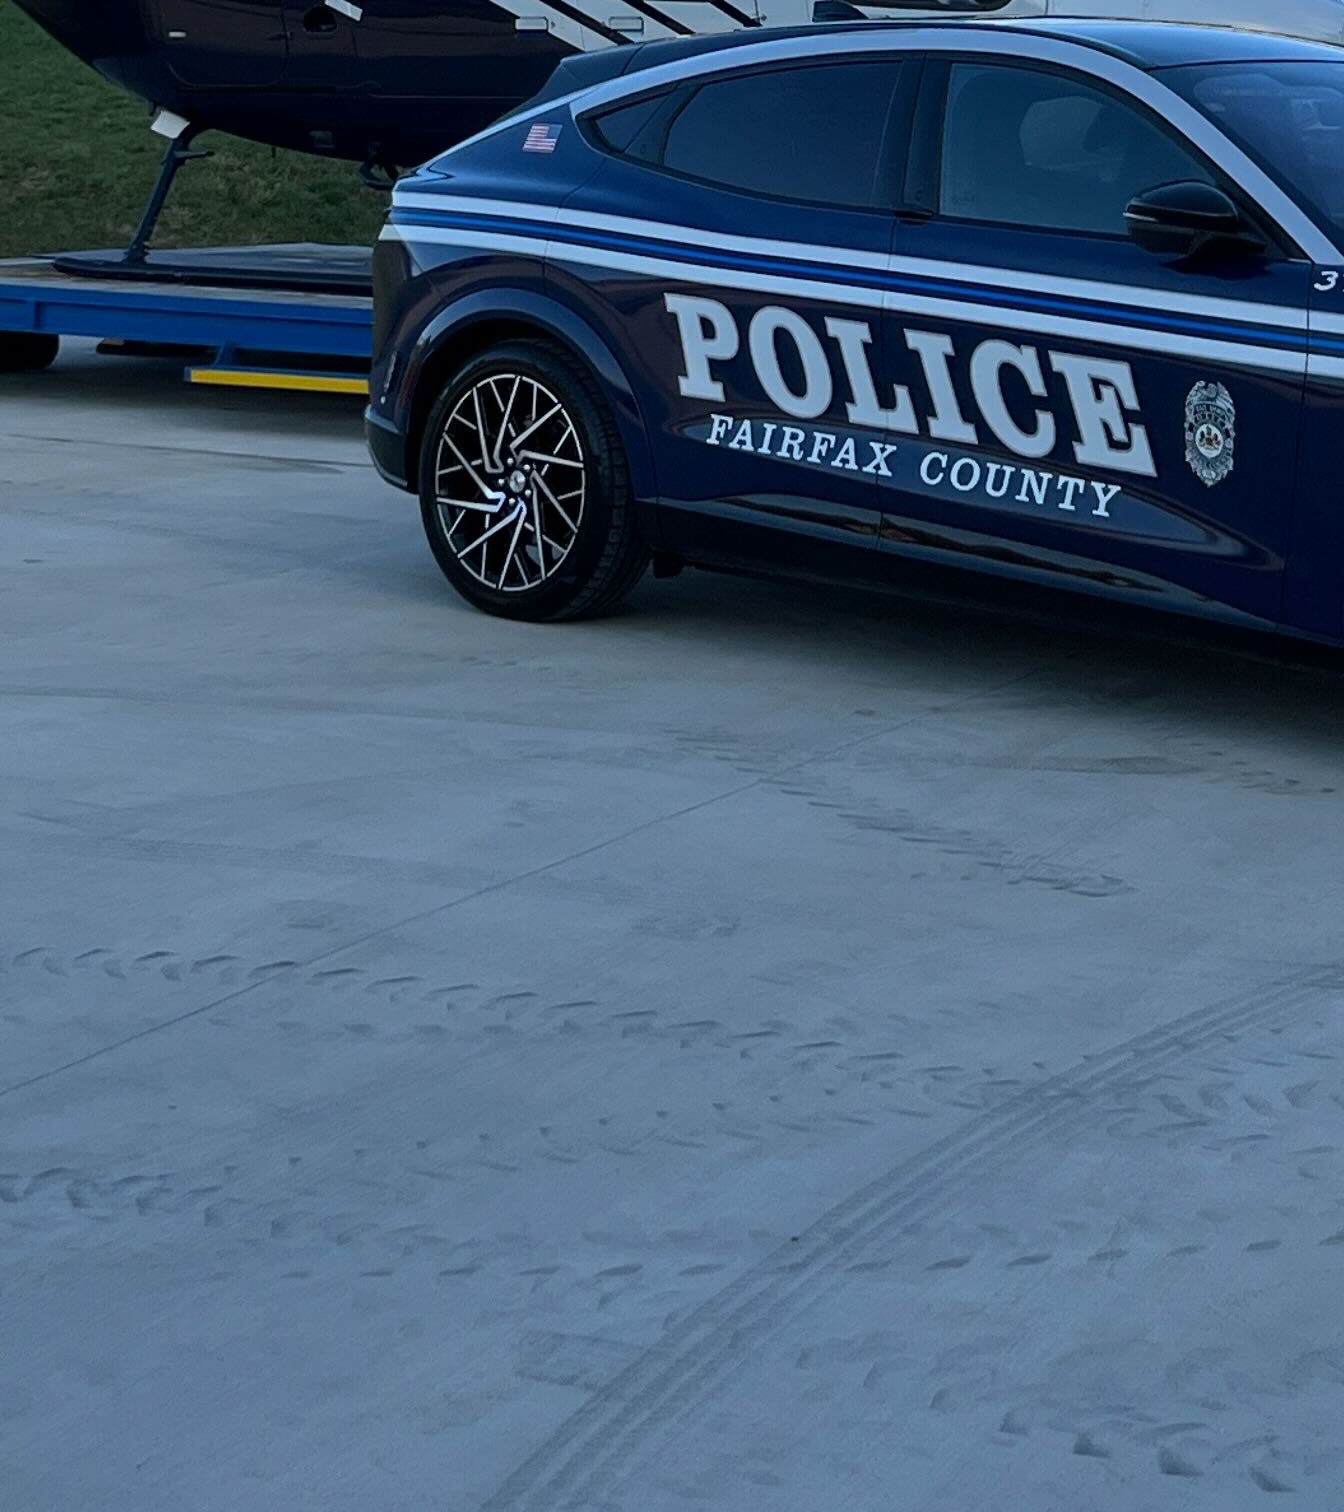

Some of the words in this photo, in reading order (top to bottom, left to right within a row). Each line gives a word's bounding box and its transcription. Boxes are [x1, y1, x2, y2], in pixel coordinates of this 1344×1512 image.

[663, 292, 1158, 478] POLICE
[706, 413, 898, 477] FAIRFAX
[919, 451, 1121, 518] COUNTY
